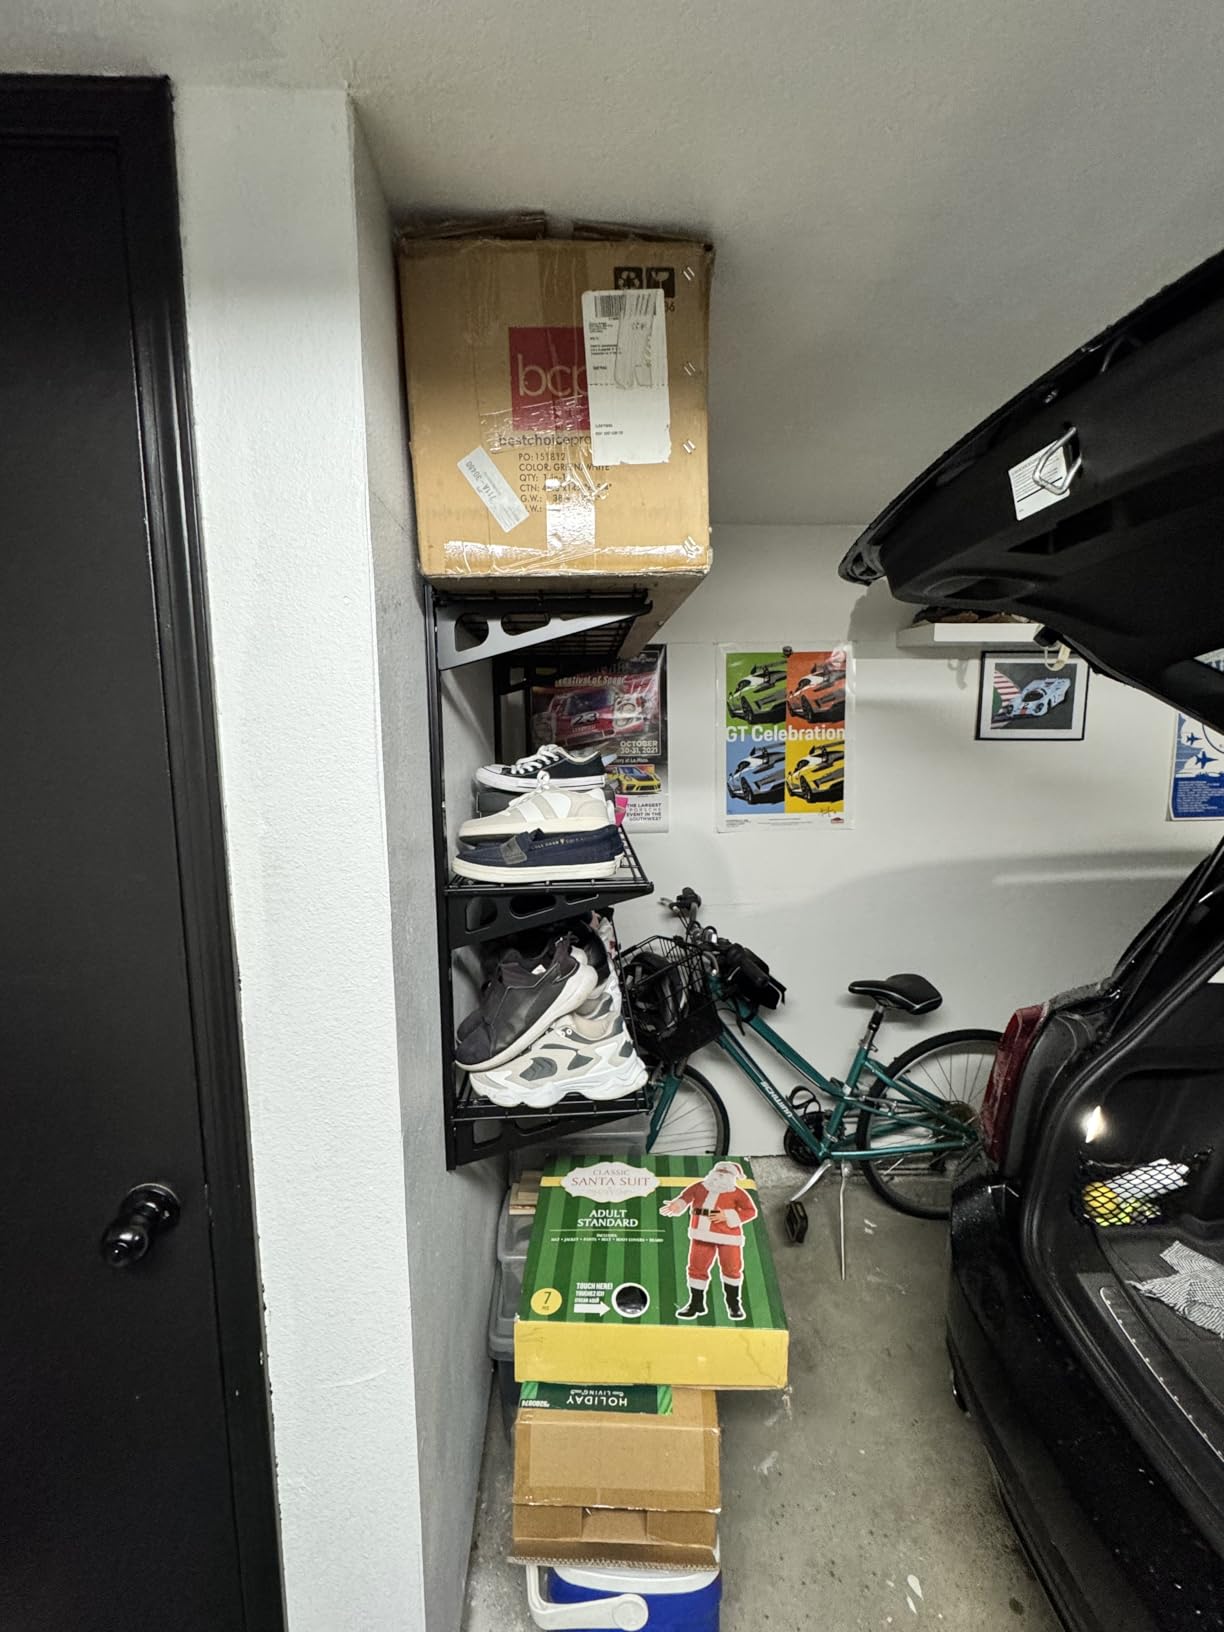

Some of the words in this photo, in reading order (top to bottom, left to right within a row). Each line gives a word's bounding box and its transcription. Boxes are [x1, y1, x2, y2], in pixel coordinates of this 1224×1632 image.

[519, 474, 538, 482] QTY:
[519, 484, 540, 492] CTN:
[520, 494, 542, 502] G.W.:
[727, 726, 749, 742] GT
[751, 725, 845, 741] Celebration
[571, 1176, 616, 1186] SANTA
[619, 1176, 650, 1186] SUIT
[589, 1209, 628, 1218] ADULT
[577, 1218, 638, 1227] STANDARD
[544, 1291, 552, 1305] 7
[583, 1389, 611, 1397] LIVING
[566, 1395, 628, 1407] HOLIDAY
